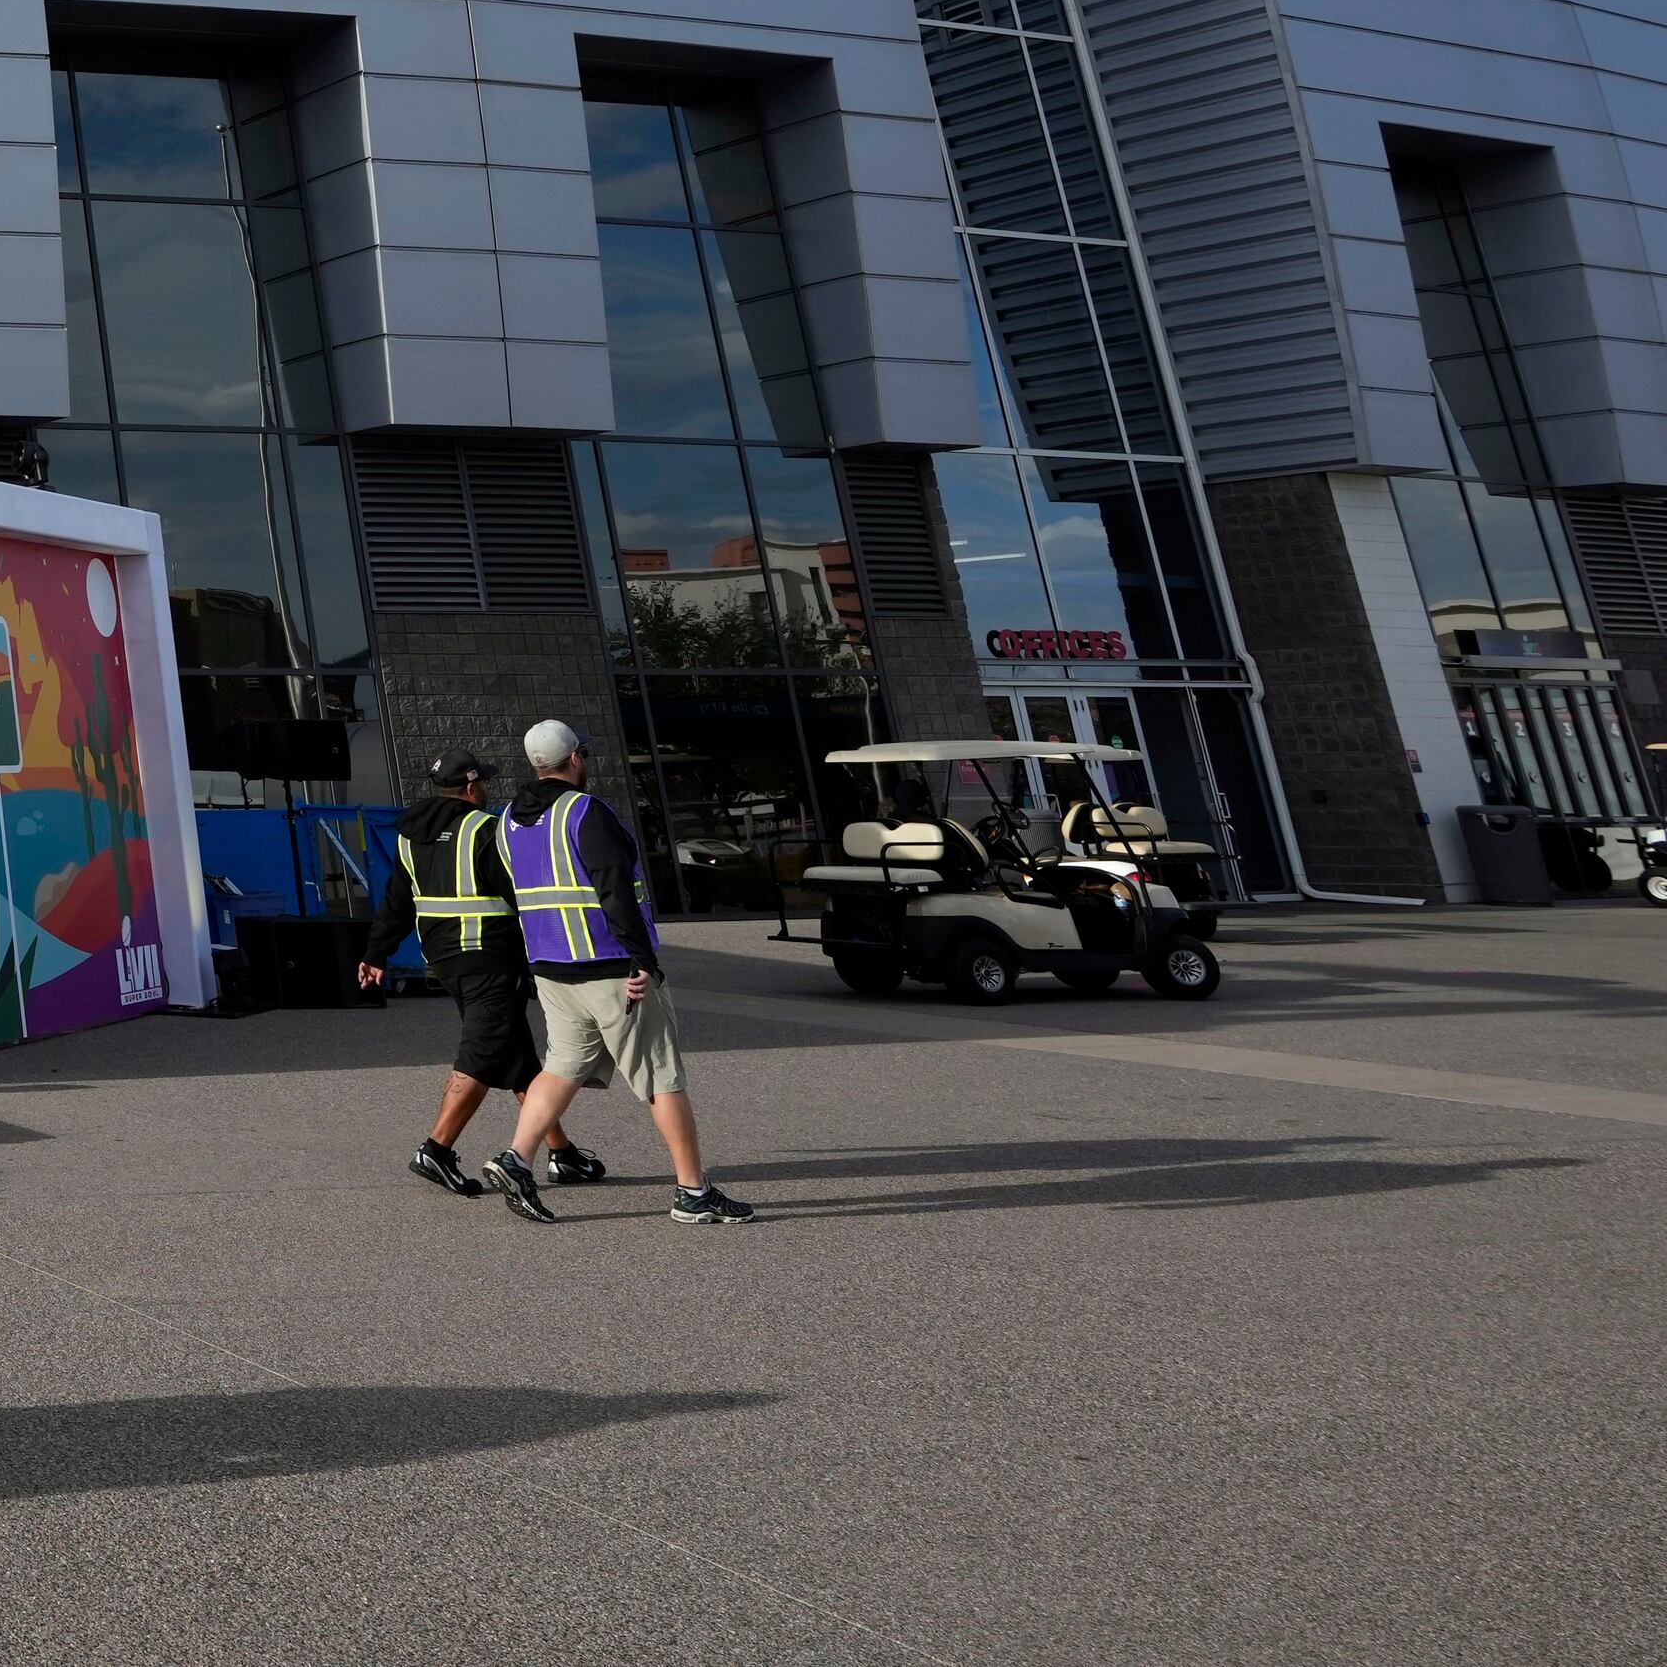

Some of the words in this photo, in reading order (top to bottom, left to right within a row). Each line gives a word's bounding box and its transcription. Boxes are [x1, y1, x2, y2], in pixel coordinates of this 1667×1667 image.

[998, 628, 1128, 661] OFFICES
[1466, 721, 1476, 736] 1
[1515, 721, 1526, 736] 2
[1563, 722, 1573, 736] 3
[116, 943, 162, 994] LVII
[125, 992, 143, 1004] SUPER
